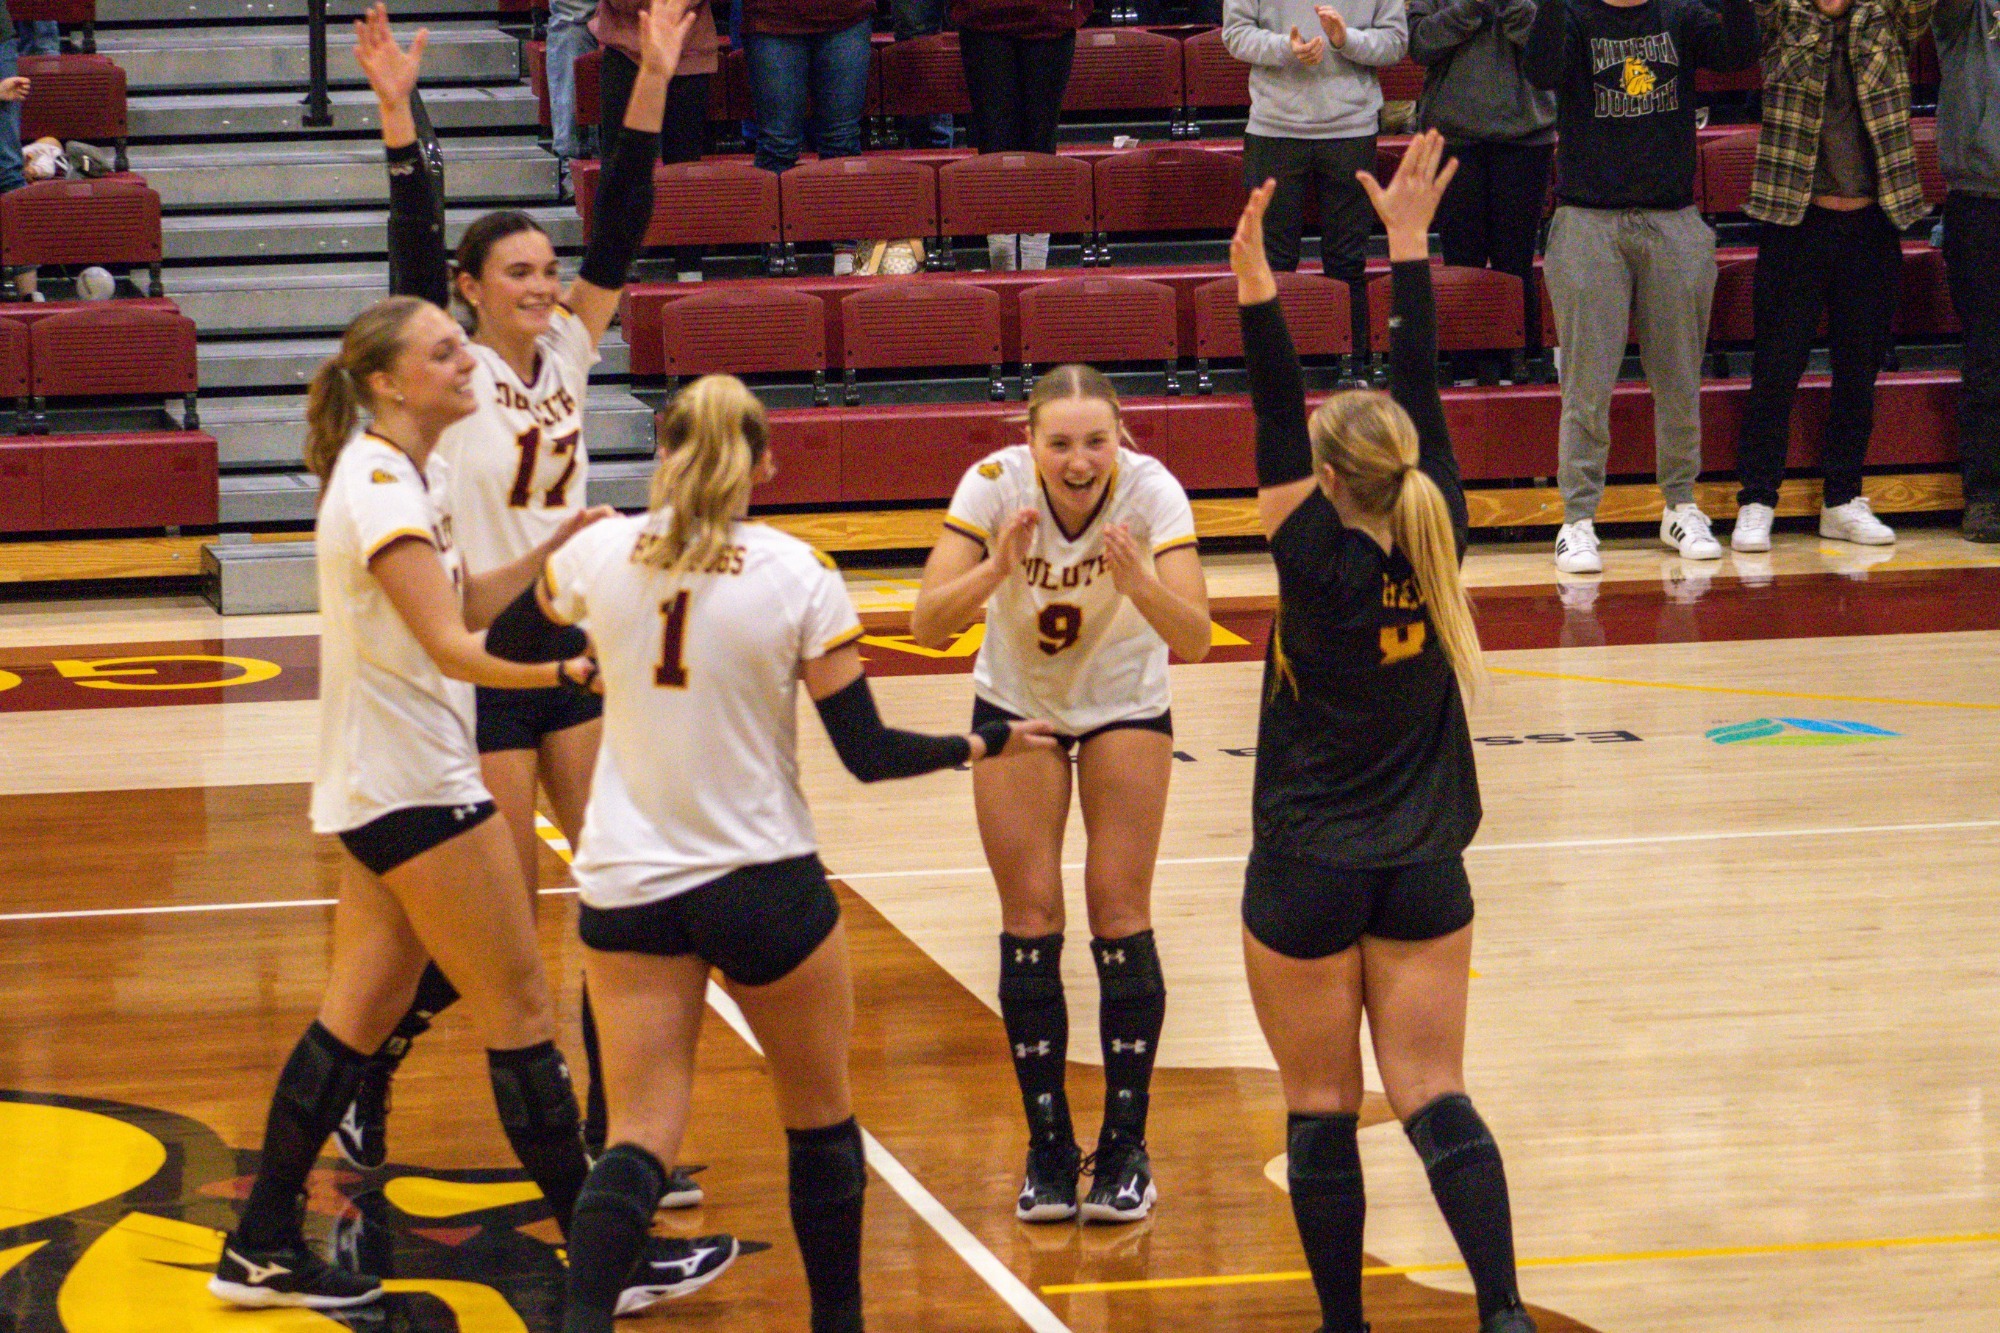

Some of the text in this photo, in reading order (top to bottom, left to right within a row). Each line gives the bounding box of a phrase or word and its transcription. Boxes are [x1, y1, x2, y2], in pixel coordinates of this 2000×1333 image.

[1593, 75, 1679, 117] DULUTH
[507, 424, 581, 508] 17
[654, 588, 691, 690] 1
[1037, 602, 1082, 656] 9
